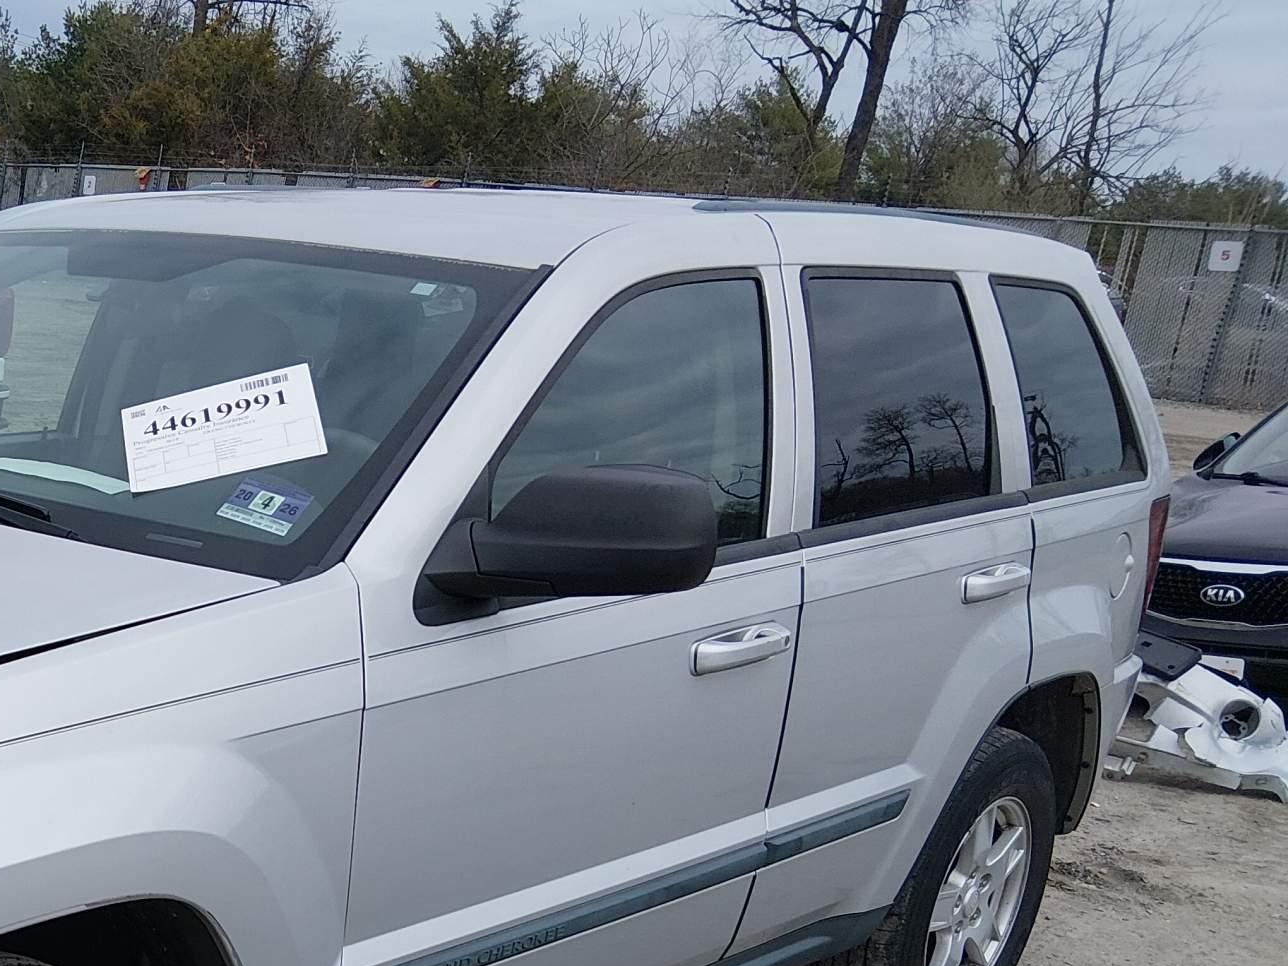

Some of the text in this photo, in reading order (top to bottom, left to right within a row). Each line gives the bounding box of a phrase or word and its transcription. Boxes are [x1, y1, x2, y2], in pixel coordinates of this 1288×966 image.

[1220, 250, 1232, 261] 5
[143, 389, 288, 436] 44619991
[234, 488, 254, 501] 20
[260, 495, 276, 510] 4
[279, 503, 300, 516] 26
[1206, 588, 1236, 603] KIA
[476, 925, 567, 966] CHEROKEE
